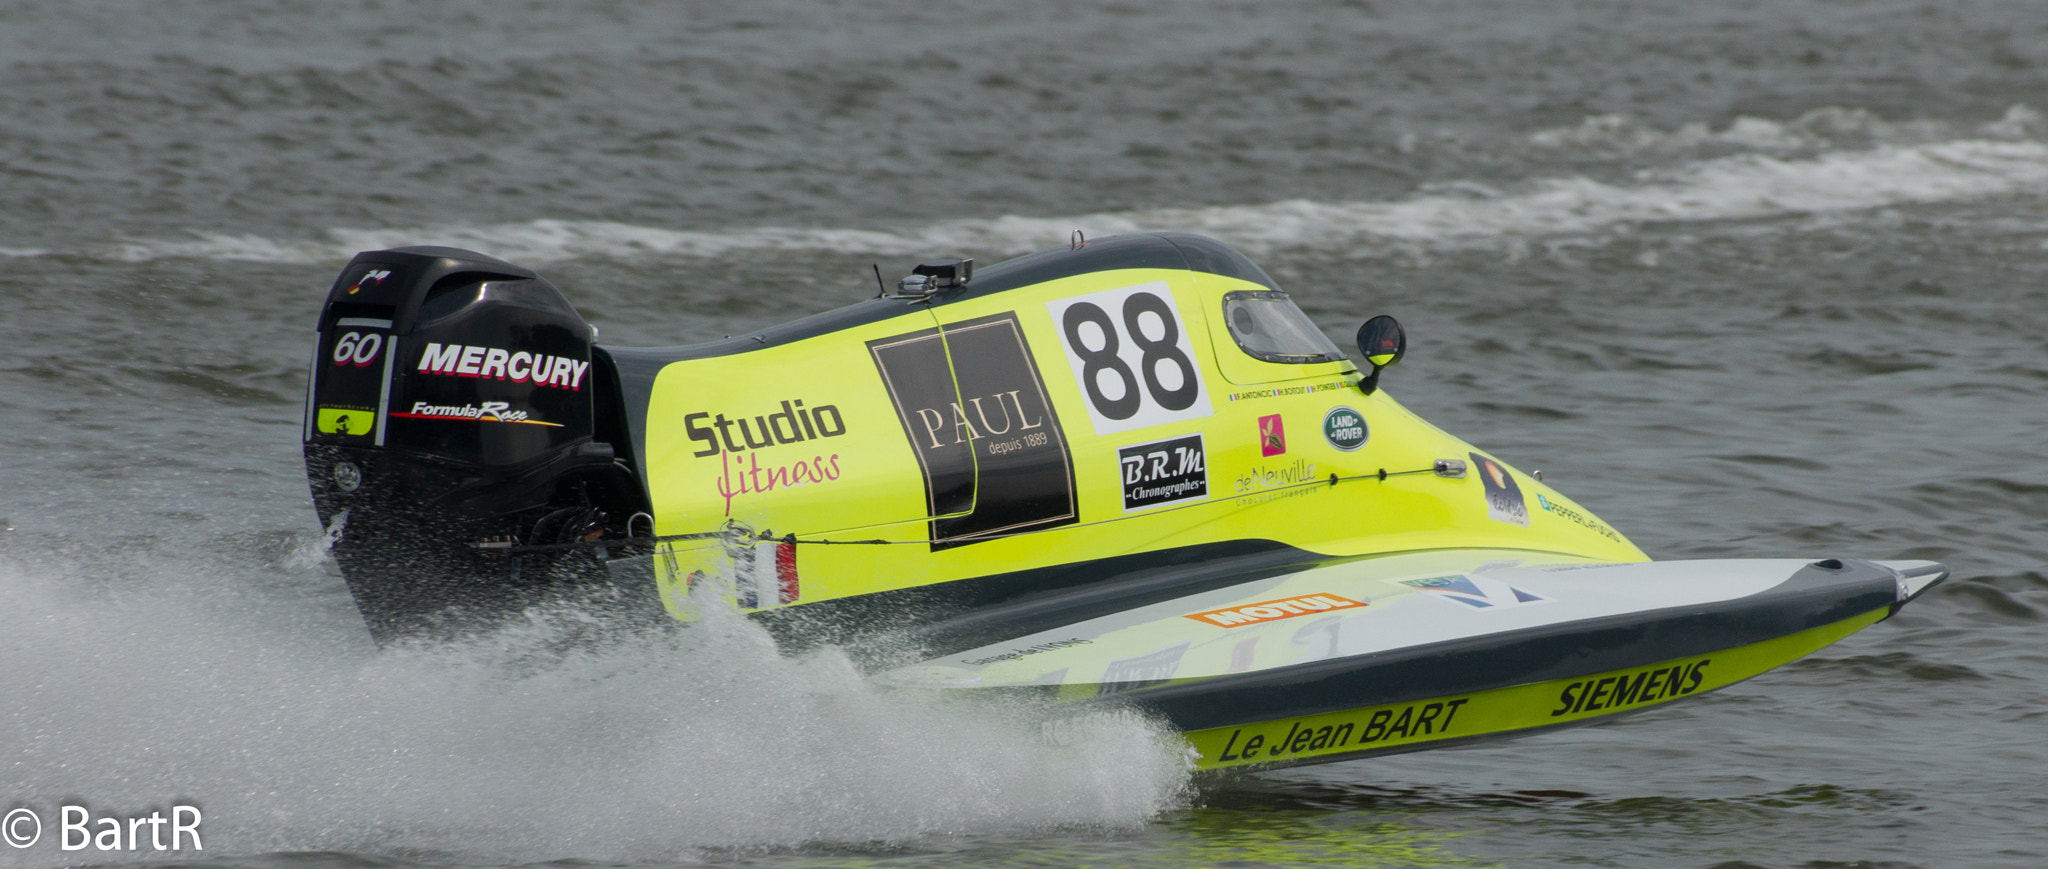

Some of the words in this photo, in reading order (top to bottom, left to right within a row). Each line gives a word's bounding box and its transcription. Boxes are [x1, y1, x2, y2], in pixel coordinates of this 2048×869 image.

[334, 331, 381, 367] 60
[418, 343, 588, 390] MERCURY
[1063, 292, 1198, 421] 88
[684, 399, 846, 458] Studio
[916, 390, 1042, 449] PAUL
[989, 437, 1022, 455] depuis
[1023, 433, 1047, 448] 1889
[1331, 416, 1353, 428] LAND
[1336, 427, 1363, 441] ROVER
[717, 449, 840, 517] fitness
[1204, 596, 1355, 626] MOTUL
[1552, 660, 1711, 717] SIEMENS
[1219, 730, 1264, 762] Le
[1270, 720, 1354, 759] Jean
[1359, 698, 1469, 744] BART
